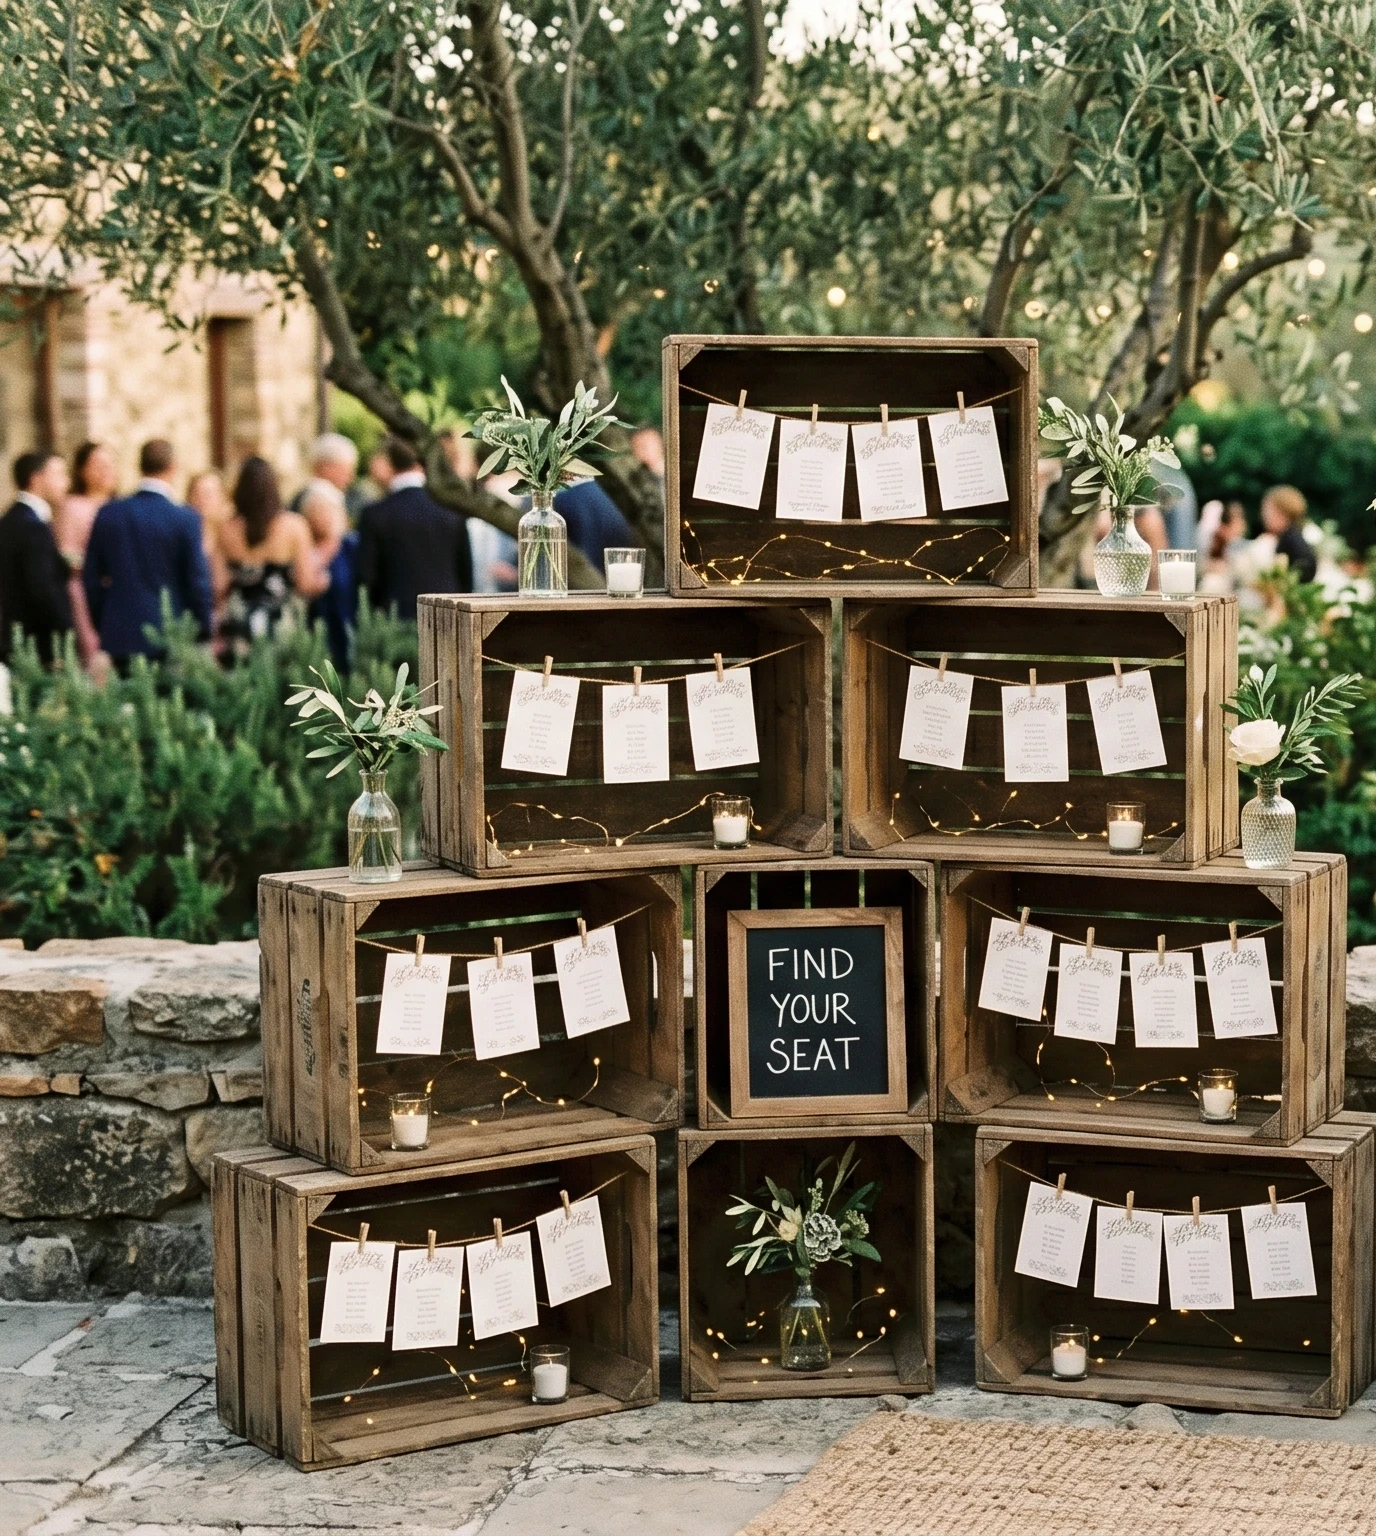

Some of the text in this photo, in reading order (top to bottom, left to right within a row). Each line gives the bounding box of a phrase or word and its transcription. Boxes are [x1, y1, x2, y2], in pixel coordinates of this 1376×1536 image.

[768, 947, 854, 981] FIND
[770, 992, 857, 1028] YOUR
[766, 1036, 861, 1075] SEAT
